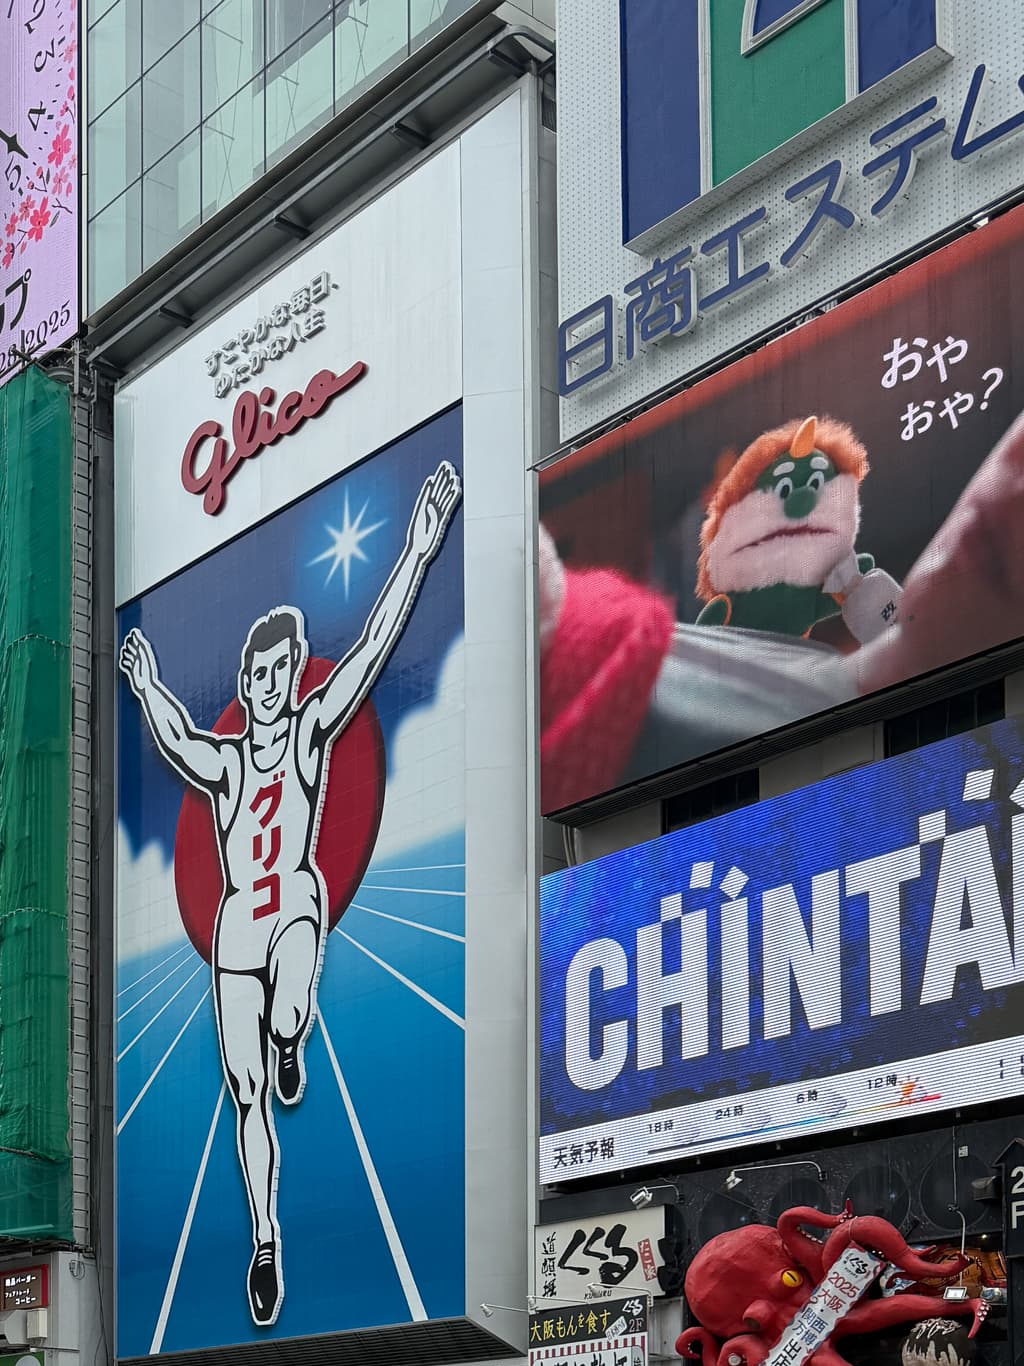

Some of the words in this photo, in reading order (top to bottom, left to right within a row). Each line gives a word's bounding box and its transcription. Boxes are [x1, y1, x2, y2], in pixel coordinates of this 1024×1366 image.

[34, 38, 55, 73] 3
[27, 100, 47, 131] 4
[4, 155, 22, 191] 5
[25, 299, 72, 349] 2025
[215, 308, 326, 399] ゆたかな人生
[880, 334, 970, 391] おや
[249, 770, 286, 921] グリコ
[552, 1136, 616, 1170] 天気予報
[541, 1231, 557, 1298] 道頓堀
[558, 1223, 639, 1289] くくる
[15, 1296, 37, 1306] コーヒー
[828, 1271, 861, 1299] 2025
[622, 1298, 643, 1316] くくる
[530, 1309, 611, 1342] 大阪もんを食す
[628, 1317, 644, 1333] 2F
